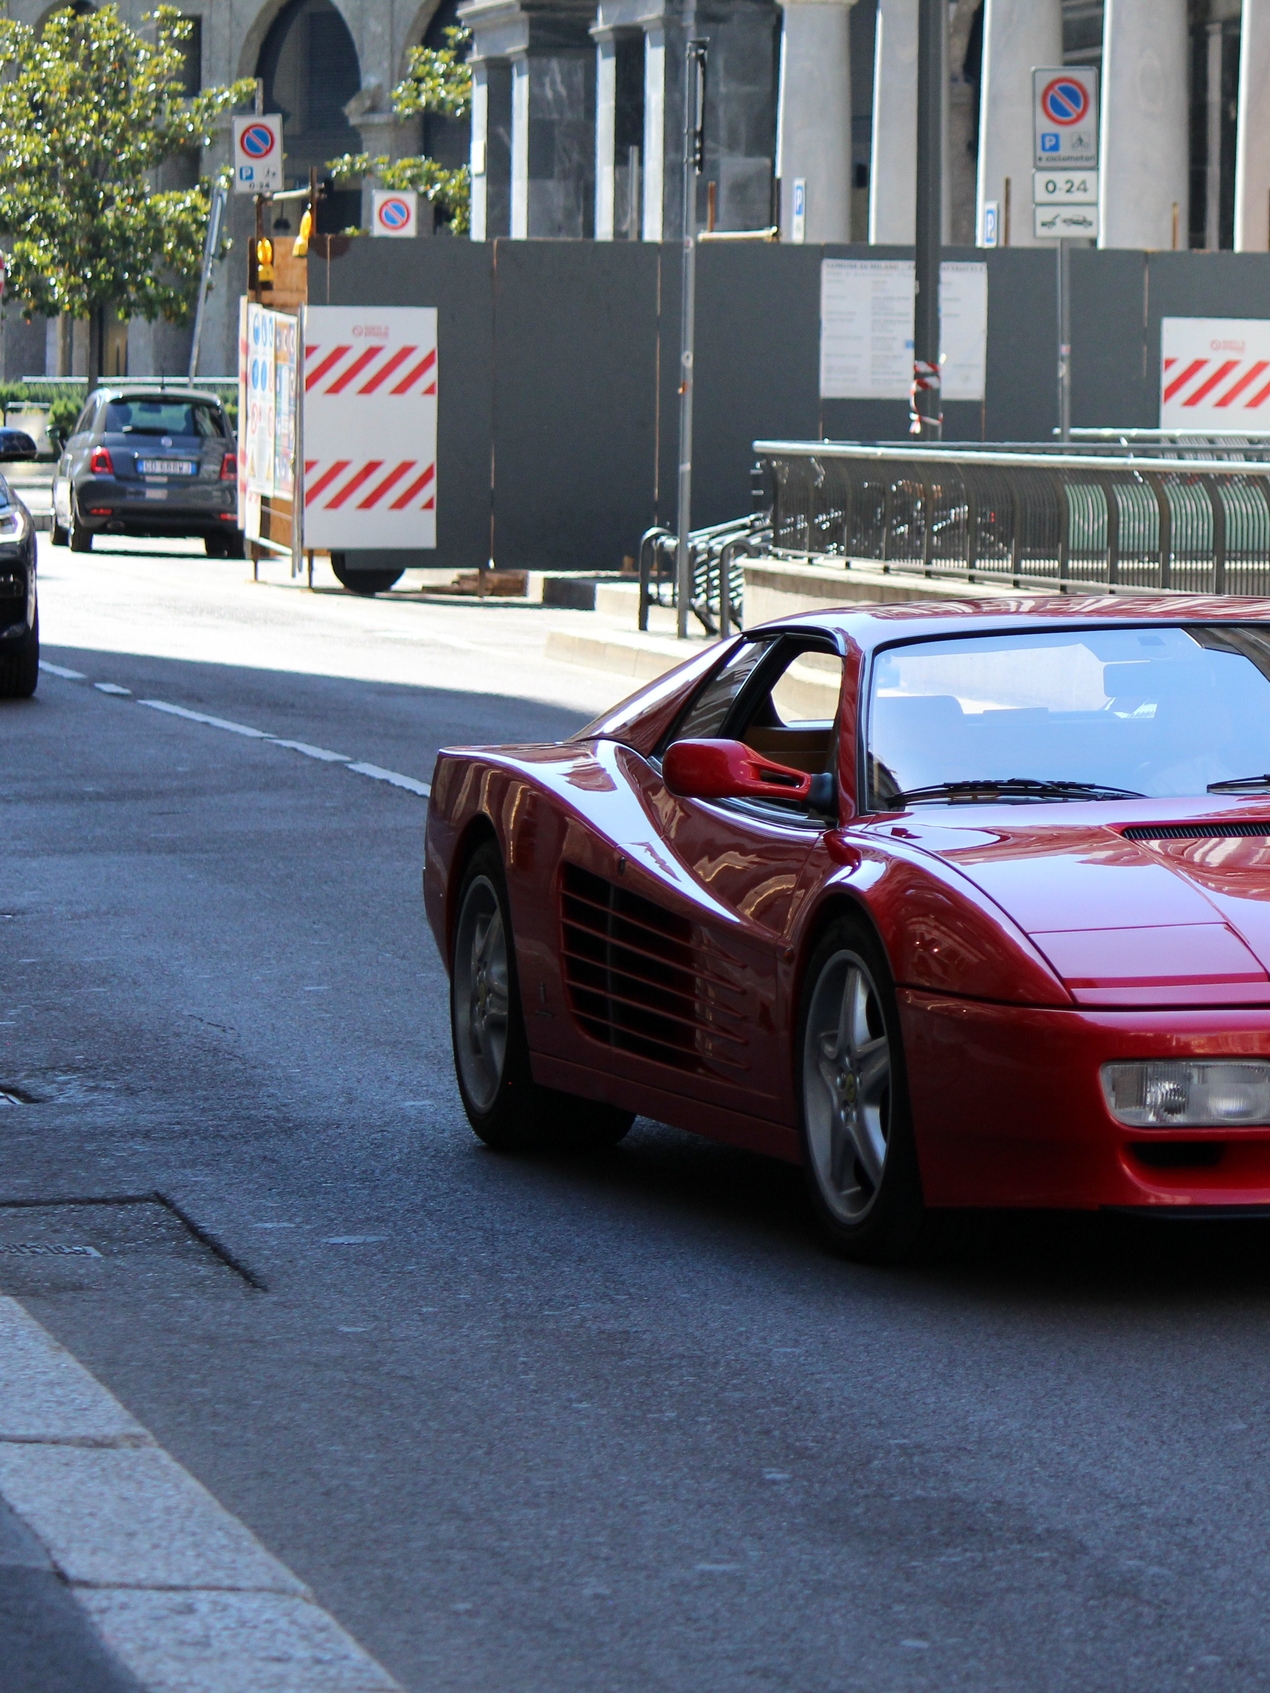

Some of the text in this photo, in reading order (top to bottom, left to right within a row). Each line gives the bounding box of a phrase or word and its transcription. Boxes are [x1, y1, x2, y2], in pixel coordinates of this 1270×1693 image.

[1044, 136, 1056, 149] P
[1045, 154, 1096, 162] ciclomotori
[241, 167, 252, 180] P
